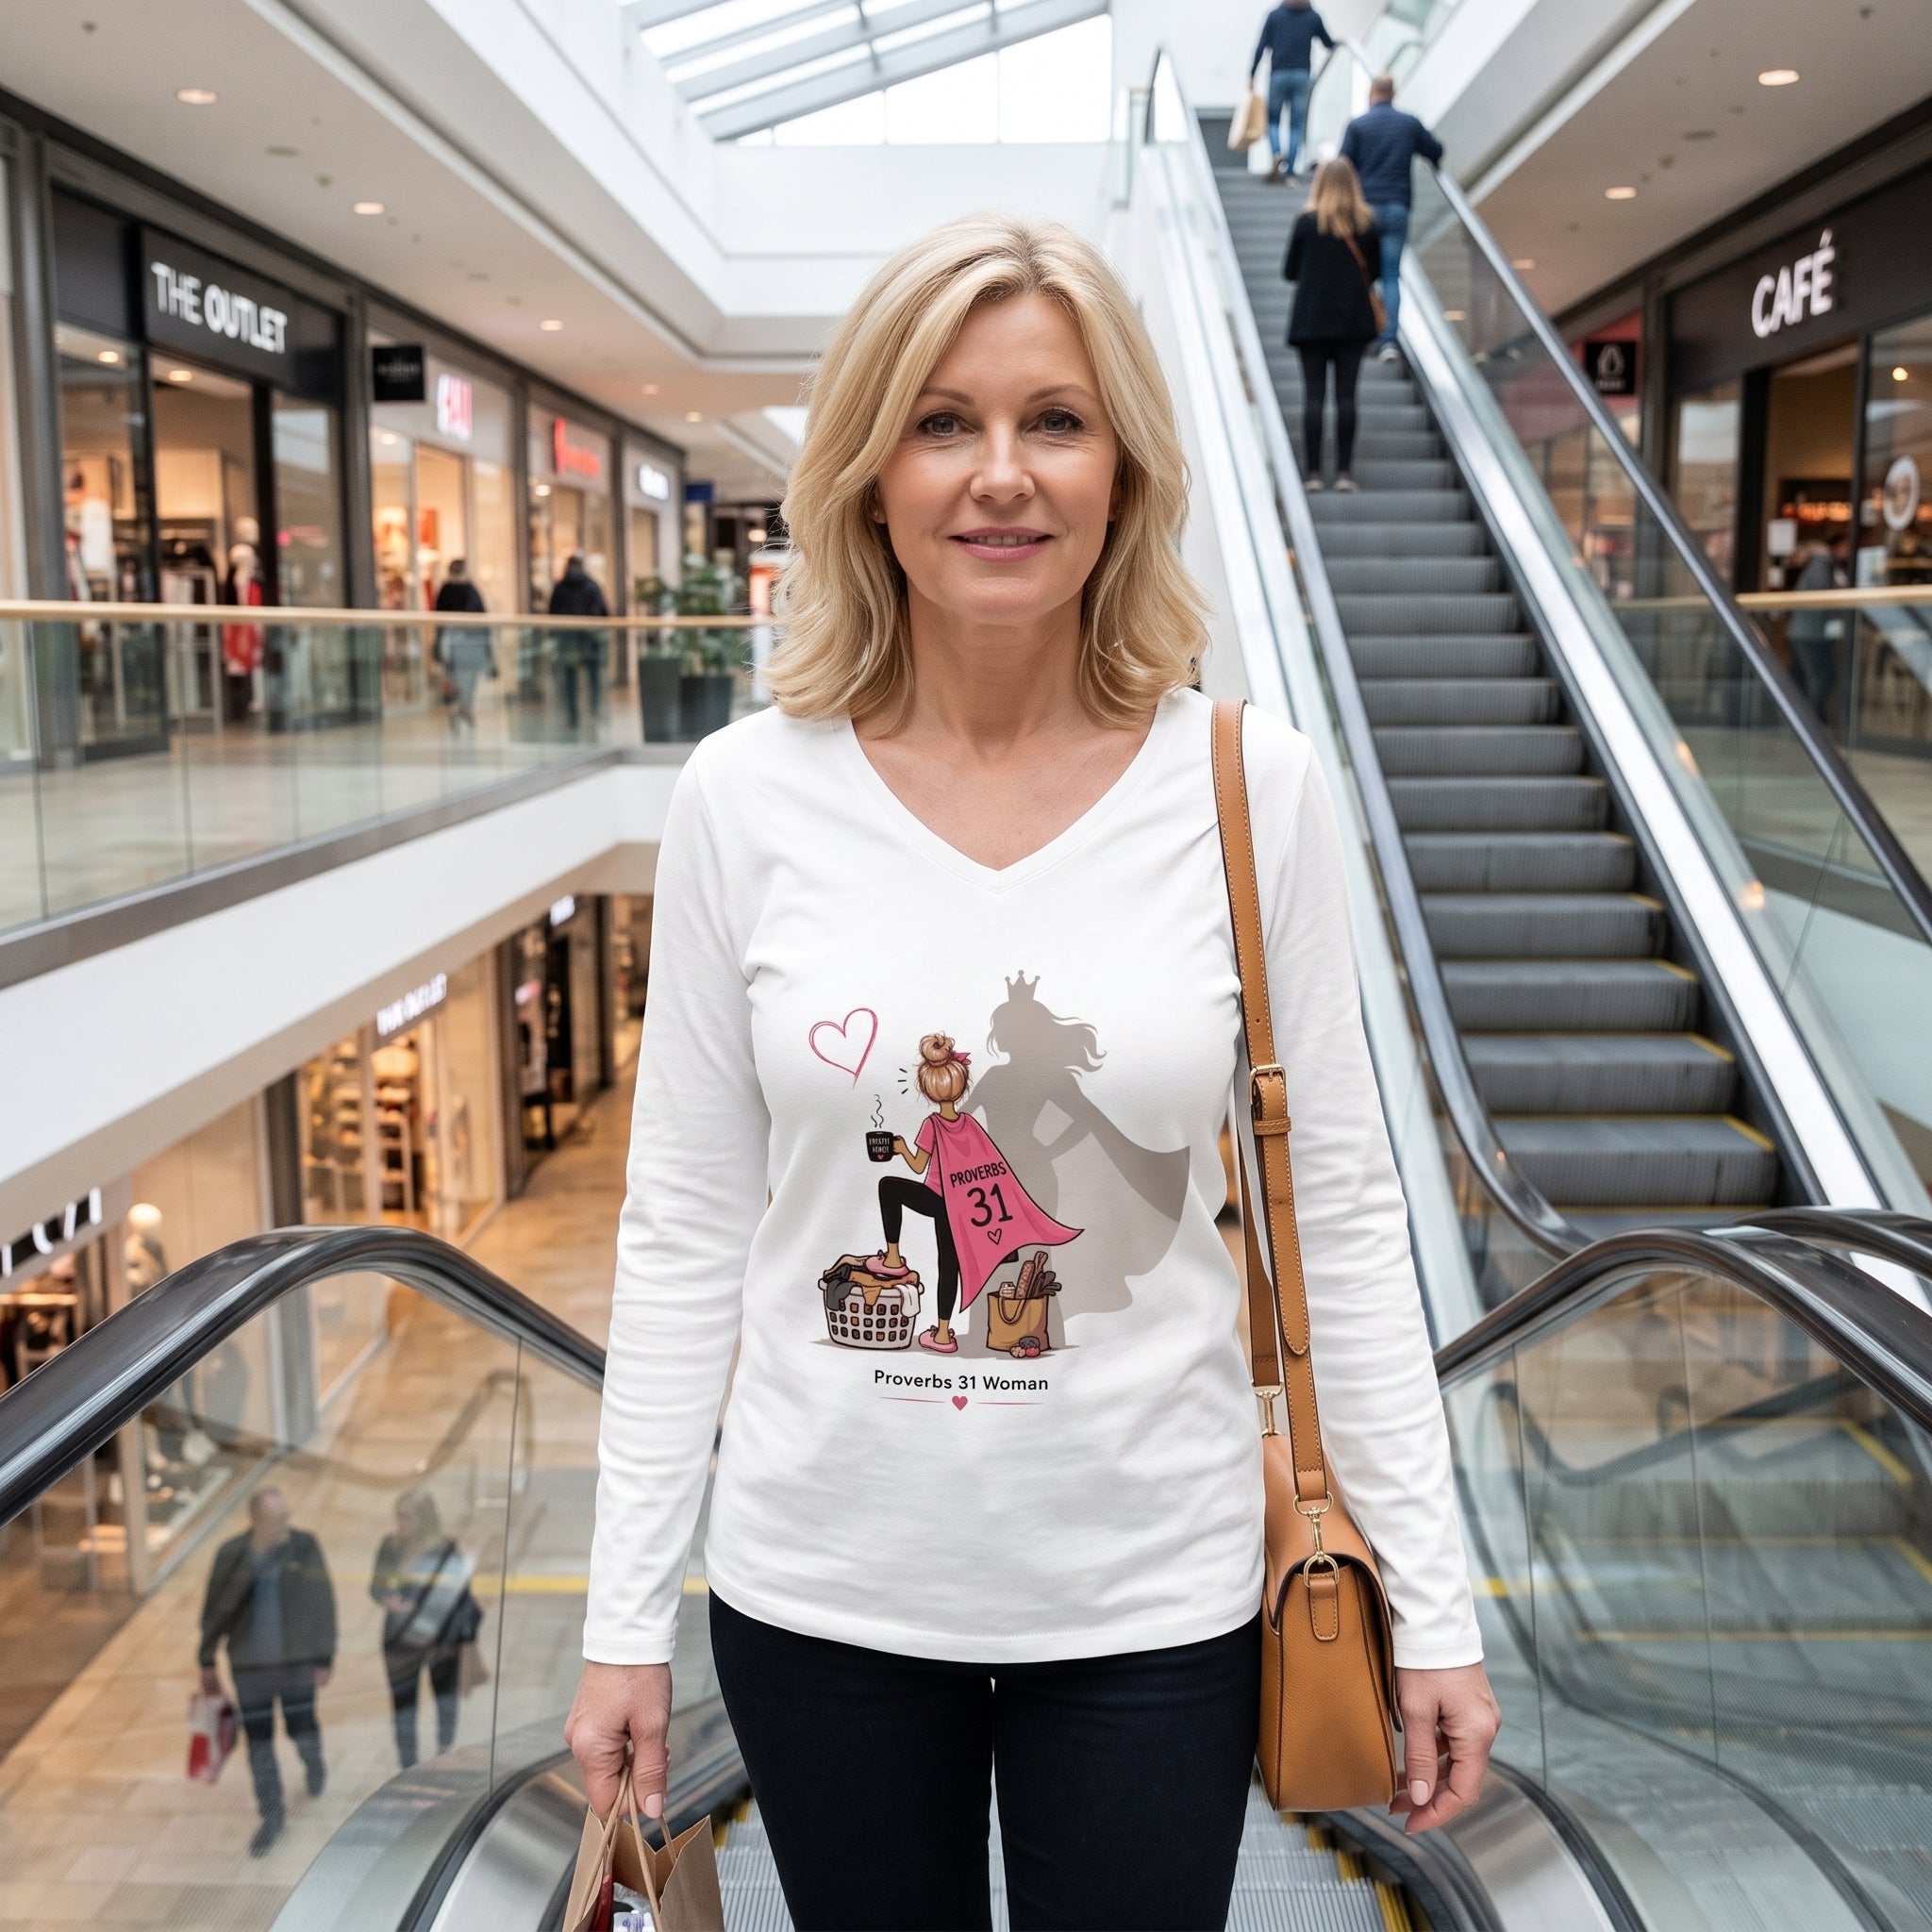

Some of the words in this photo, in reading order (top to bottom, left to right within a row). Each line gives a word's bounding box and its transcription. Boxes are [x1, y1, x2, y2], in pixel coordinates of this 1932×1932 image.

[1752, 228, 1835, 338] CAFÉ
[151, 261, 203, 325] THE
[204, 284, 288, 354] OUTLET
[950, 1162, 1007, 1188] PROVERBS
[967, 1183, 1013, 1226] 31
[874, 1370, 952, 1389] Proverbs
[958, 1375, 975, 1390] 31
[983, 1376, 1048, 1391] Woman
